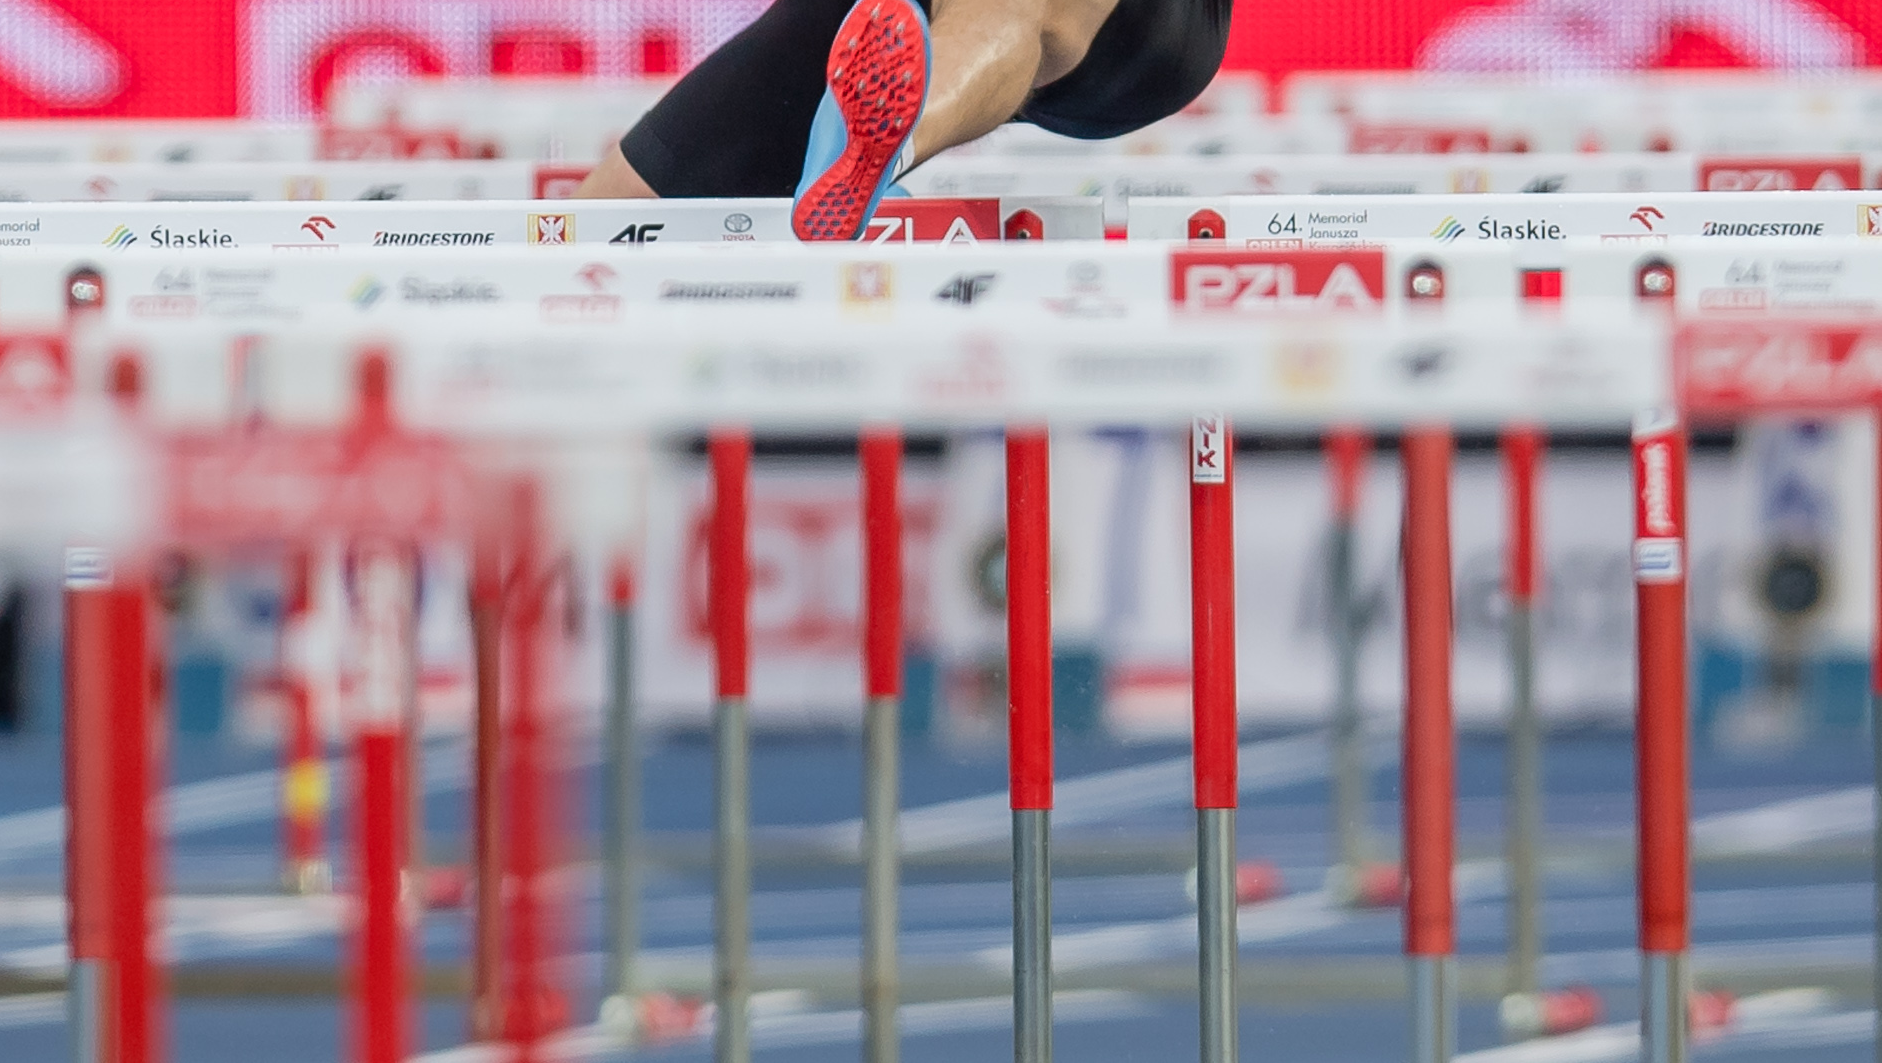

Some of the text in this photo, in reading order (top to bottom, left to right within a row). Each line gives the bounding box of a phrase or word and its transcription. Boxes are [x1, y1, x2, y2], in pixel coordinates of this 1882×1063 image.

[1267, 210, 1368, 235] 64. Memoriał
[1702, 222, 1825, 237] BRIDGESTONE
[369, 231, 495, 247] BRIDGESTONE
[722, 234, 756, 242] TOYOTA
[857, 216, 981, 250] ZLA
[1309, 227, 1358, 239] Janusza
[1184, 262, 1375, 313] PZLA
